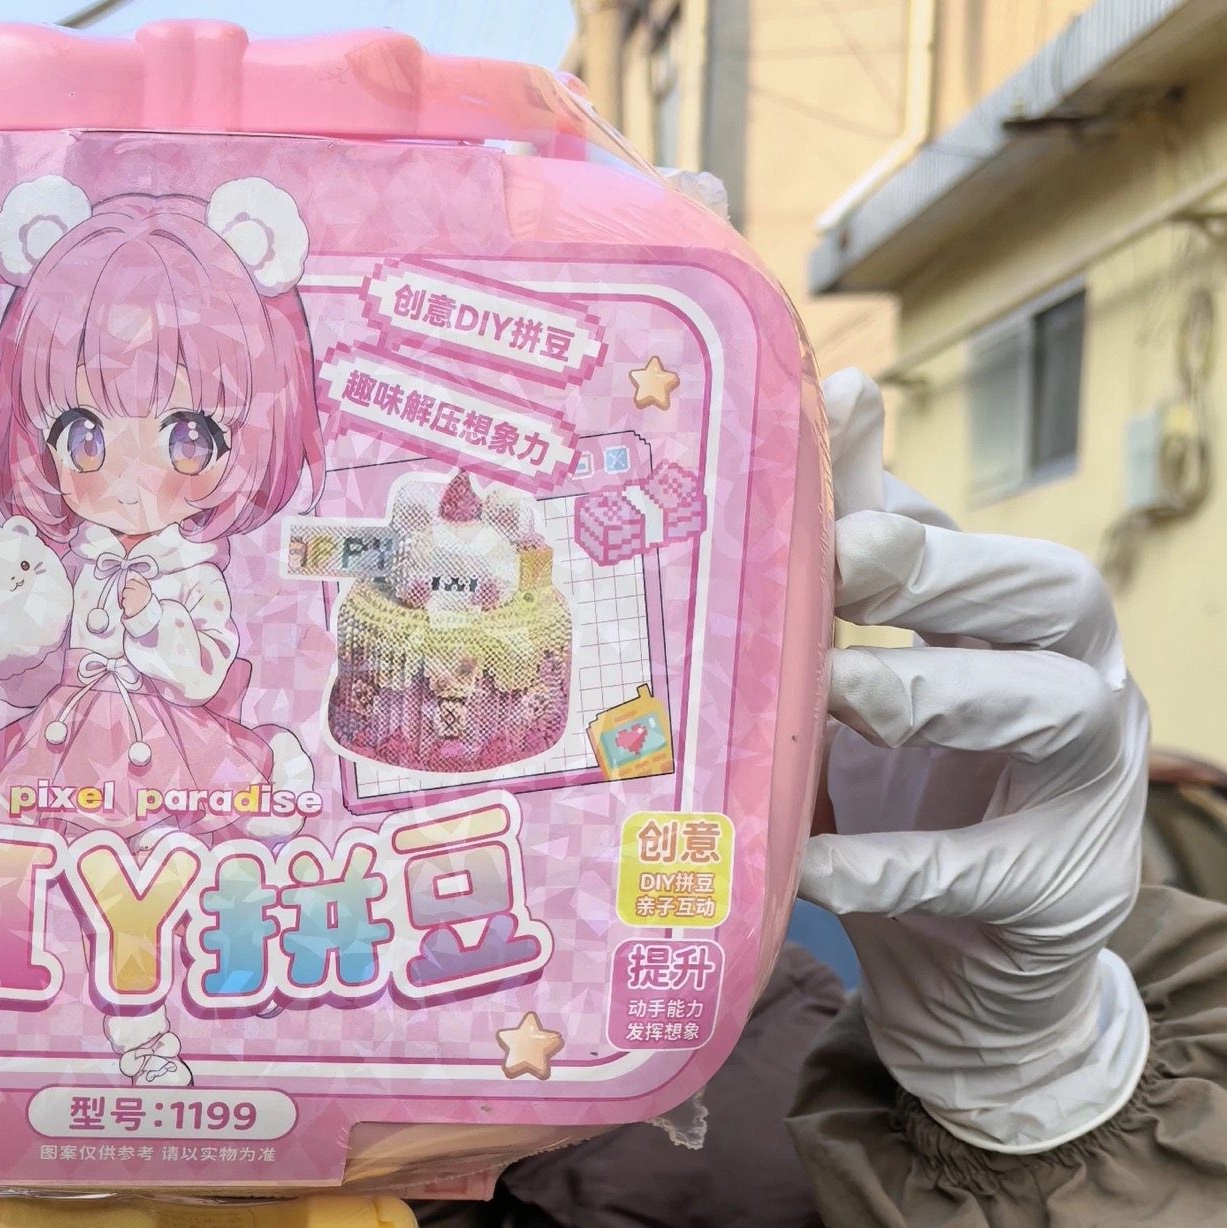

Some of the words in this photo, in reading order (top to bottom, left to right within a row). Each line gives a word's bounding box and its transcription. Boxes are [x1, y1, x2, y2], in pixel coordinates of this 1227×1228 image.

[393, 283, 576, 363] 创意DIY拼豆
[341, 370, 551, 467] 趣味解压想象力
[9, 779, 114, 818] pixel
[136, 784, 322, 820] paradise
[637, 820, 721, 865] 创意
[639, 872, 715, 894] DIY拼豆
[636, 896, 716, 917] 亲子互动
[628, 945, 715, 990] 提升
[627, 1000, 704, 1018] 动手能力
[625, 1023, 700, 1041] 发挥想象
[69, 1096, 257, 1131] 型号:1199
[40, 1145, 154, 1161] 图案仅供参考
[162, 1146, 276, 1162] 请以实物为准
